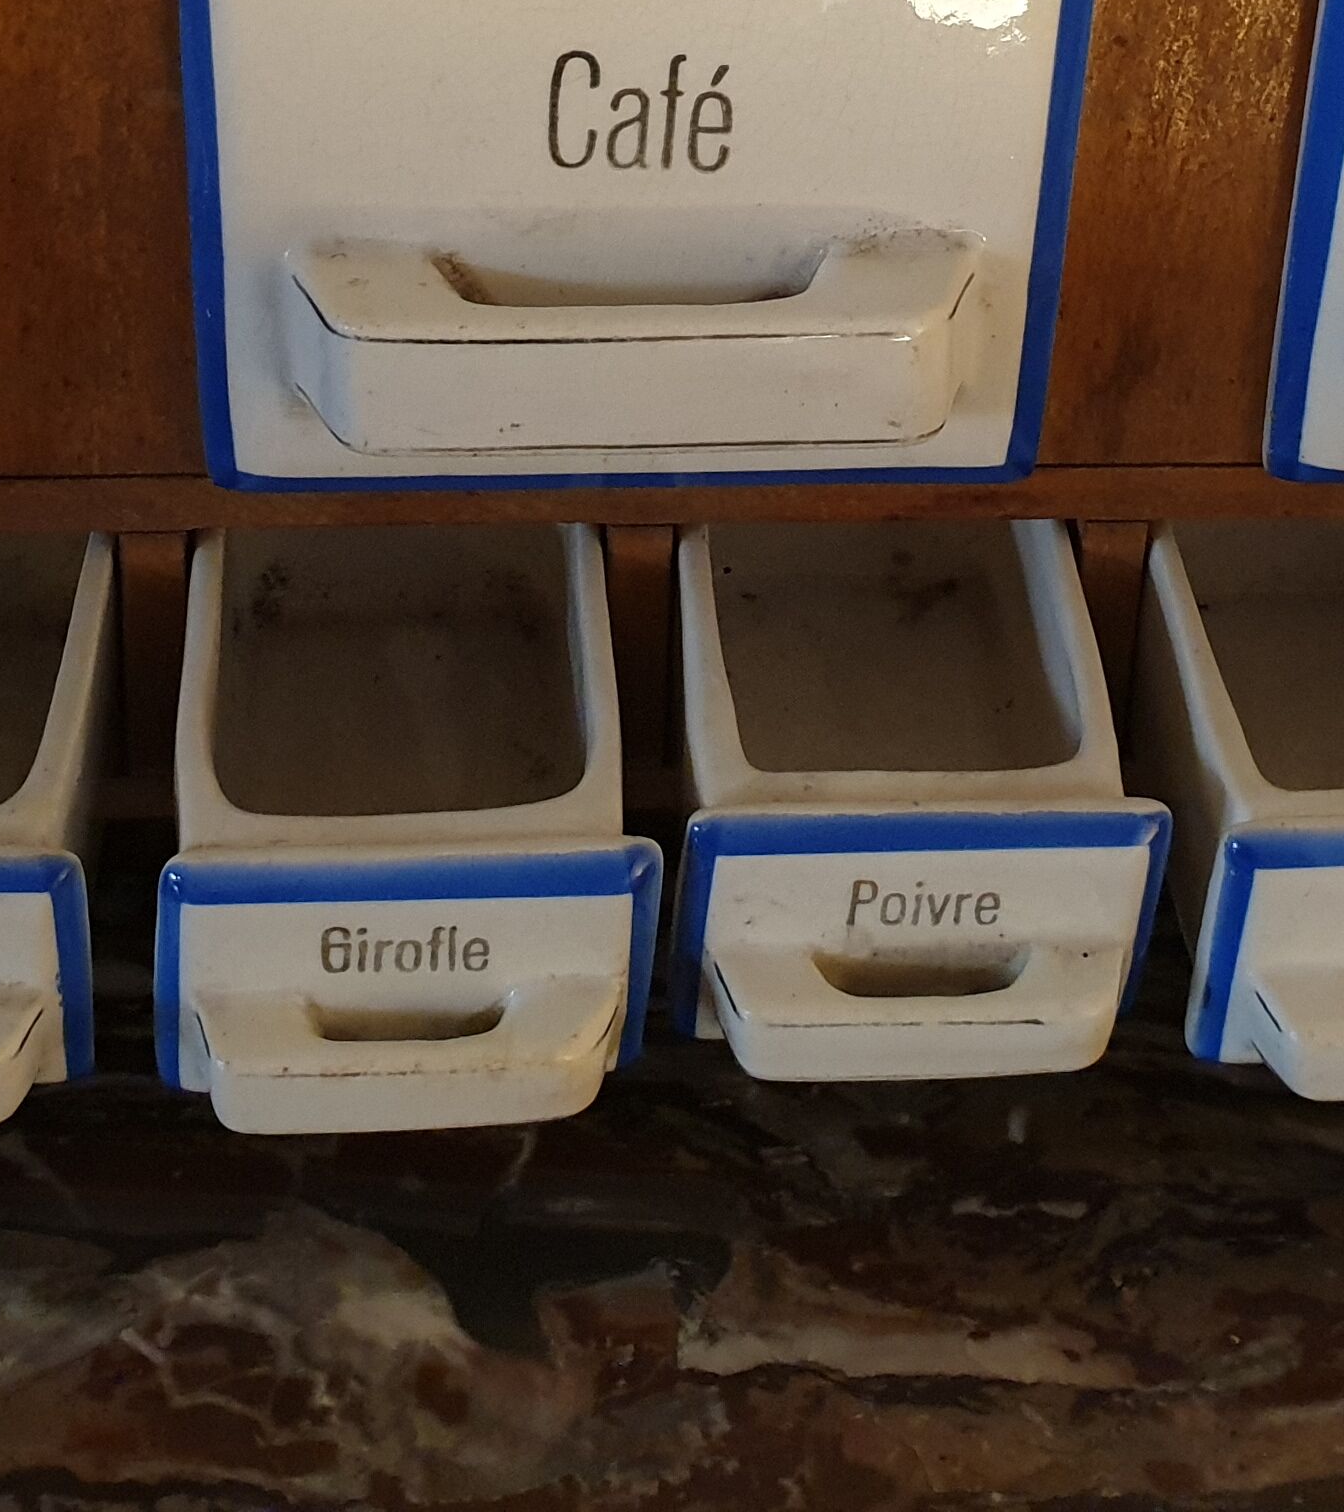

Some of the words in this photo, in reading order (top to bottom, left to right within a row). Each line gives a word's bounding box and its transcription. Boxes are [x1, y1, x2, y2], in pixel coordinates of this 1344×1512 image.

[548, 50, 733, 173] Café
[846, 879, 1001, 927] Poivre
[320, 925, 491, 974] Girofle
